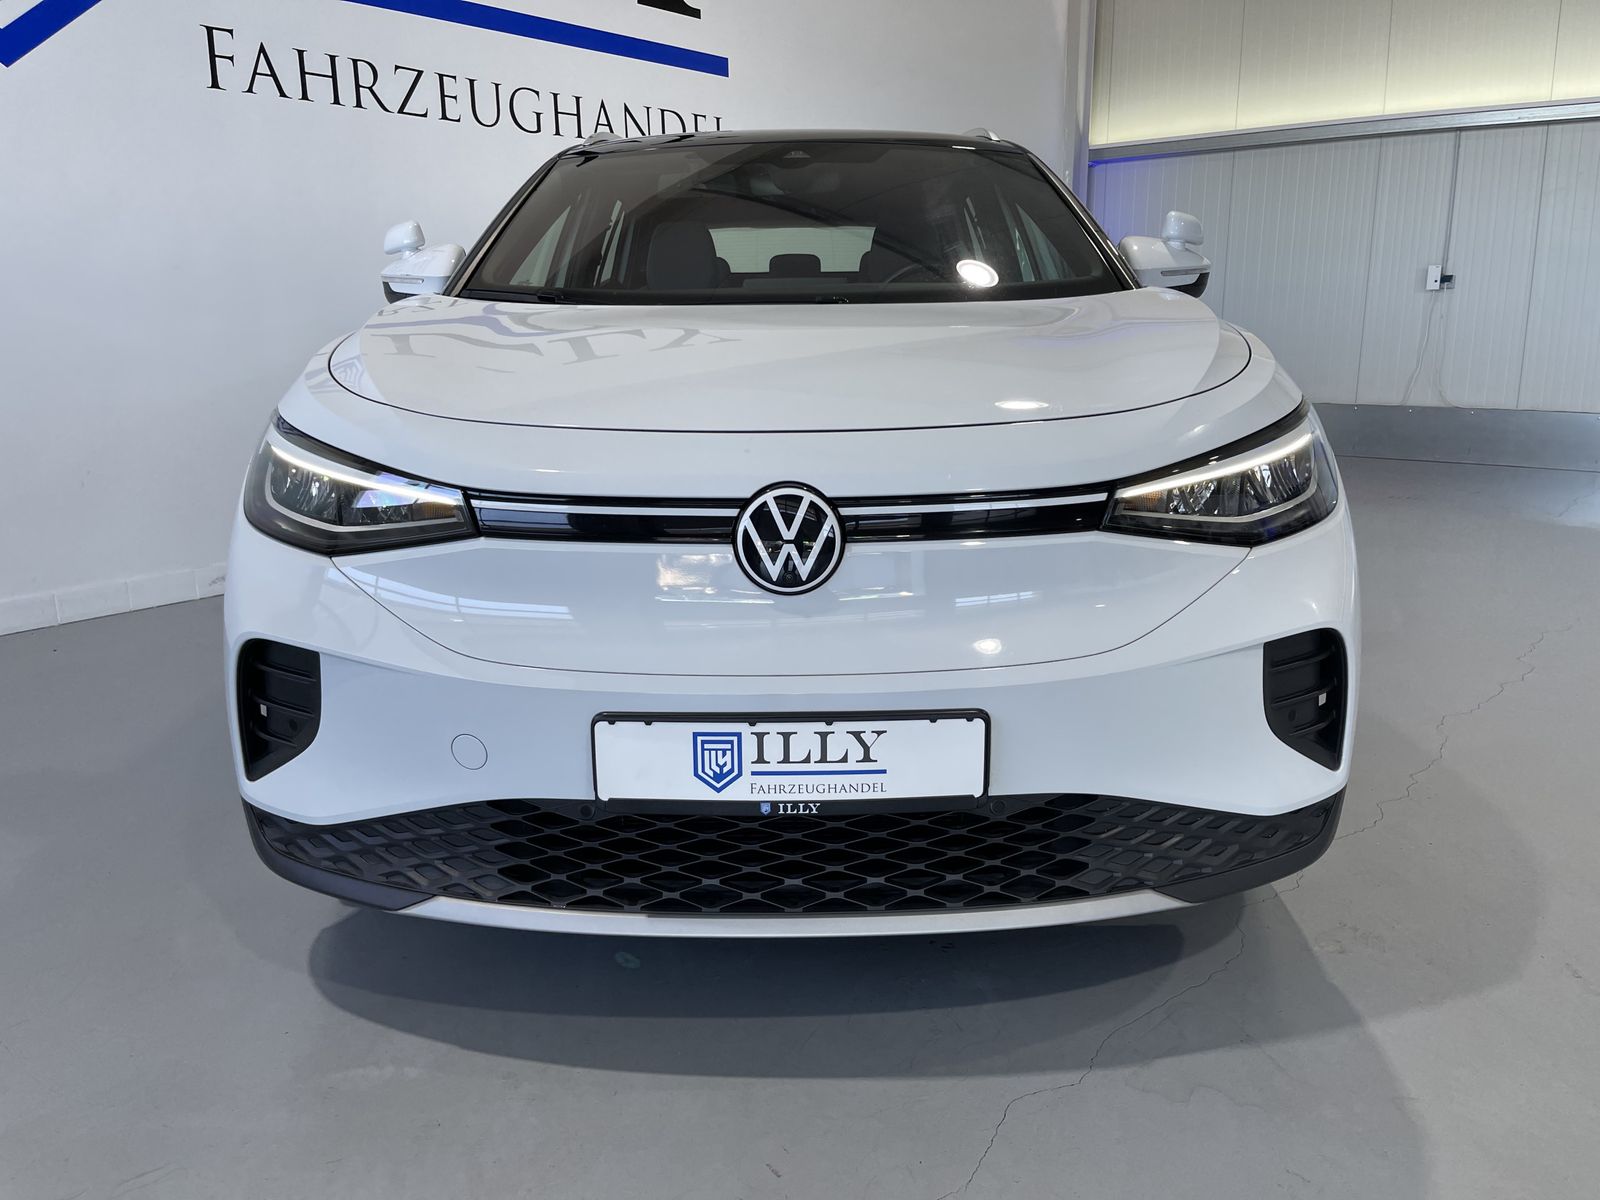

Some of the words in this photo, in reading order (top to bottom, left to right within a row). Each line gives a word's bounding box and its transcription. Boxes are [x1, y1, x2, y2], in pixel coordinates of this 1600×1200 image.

[742, 489, 836, 582] VW
[750, 730, 887, 764] ILLY
[750, 782, 887, 794] FAHRZEUGHANDEL
[778, 803, 821, 814] ILLY
